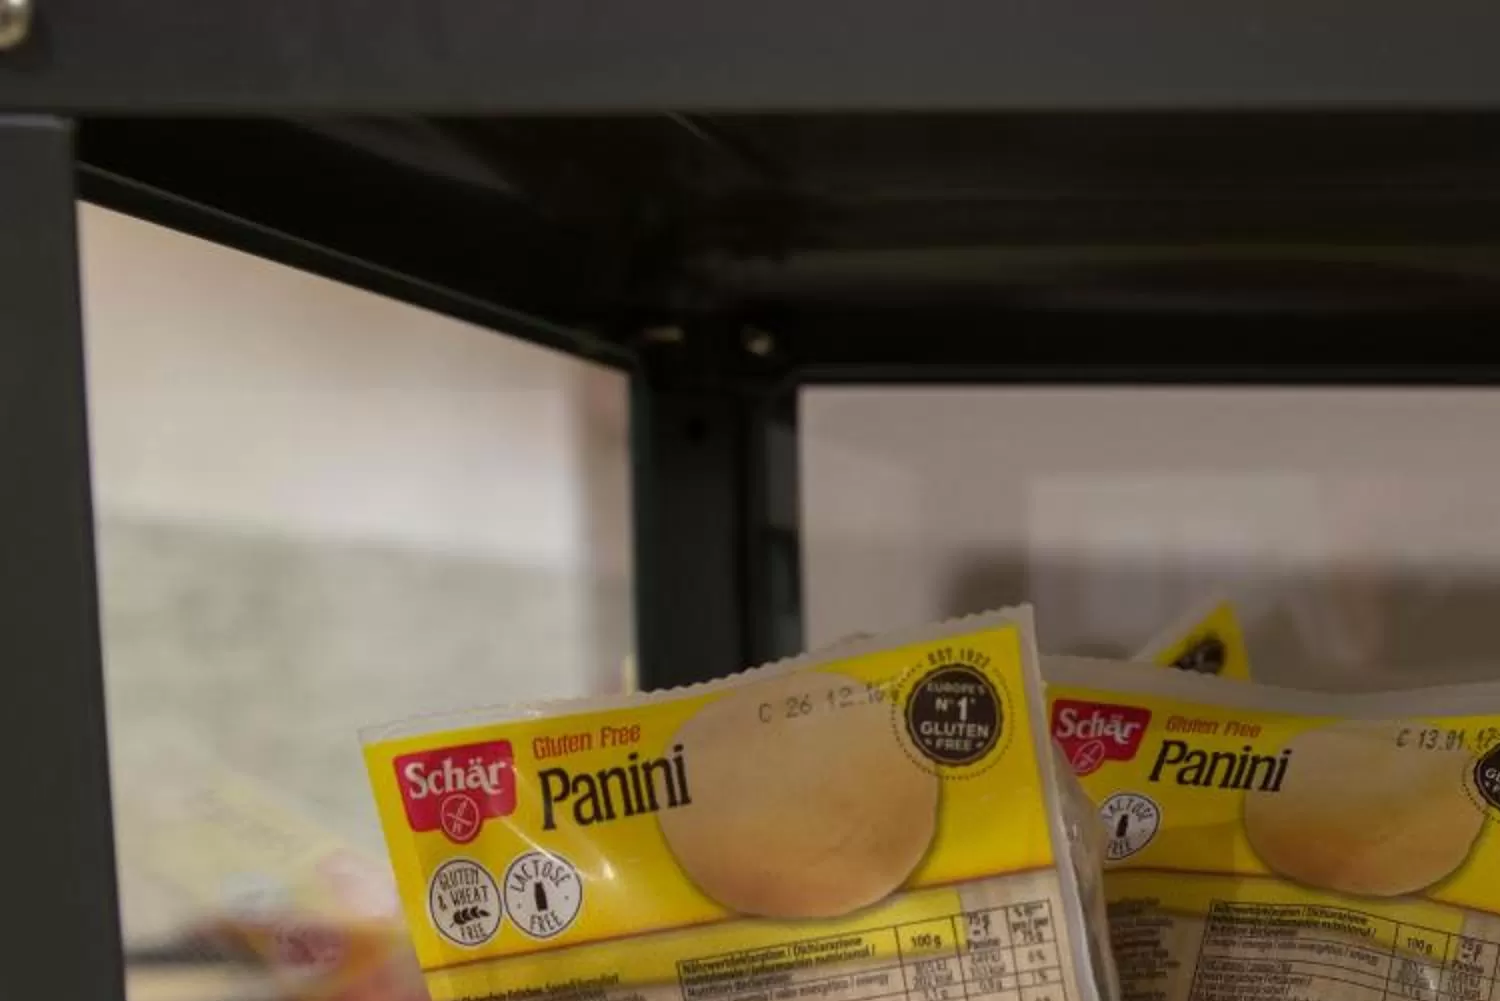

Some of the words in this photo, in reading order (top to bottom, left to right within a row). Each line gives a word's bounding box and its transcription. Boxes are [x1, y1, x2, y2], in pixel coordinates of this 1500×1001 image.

[920, 720, 989, 740] GLUTEN
[1056, 708, 1141, 745] Schär
[1165, 715, 1219, 736] Gluten
[1224, 722, 1263, 739] Free
[532, 734, 592, 761] Gluten
[600, 724, 641, 749] Free
[935, 738, 973, 752] FREE
[1148, 738, 1293, 793] Panini
[404, 756, 508, 801] Schär
[538, 744, 693, 832] Panini
[438, 867, 481, 891] GLUTEN
[509, 859, 572, 894] LACTOSE
[450, 884, 490, 907] WHEAT
[460, 923, 487, 941] FREE
[530, 911, 564, 933] FREE
